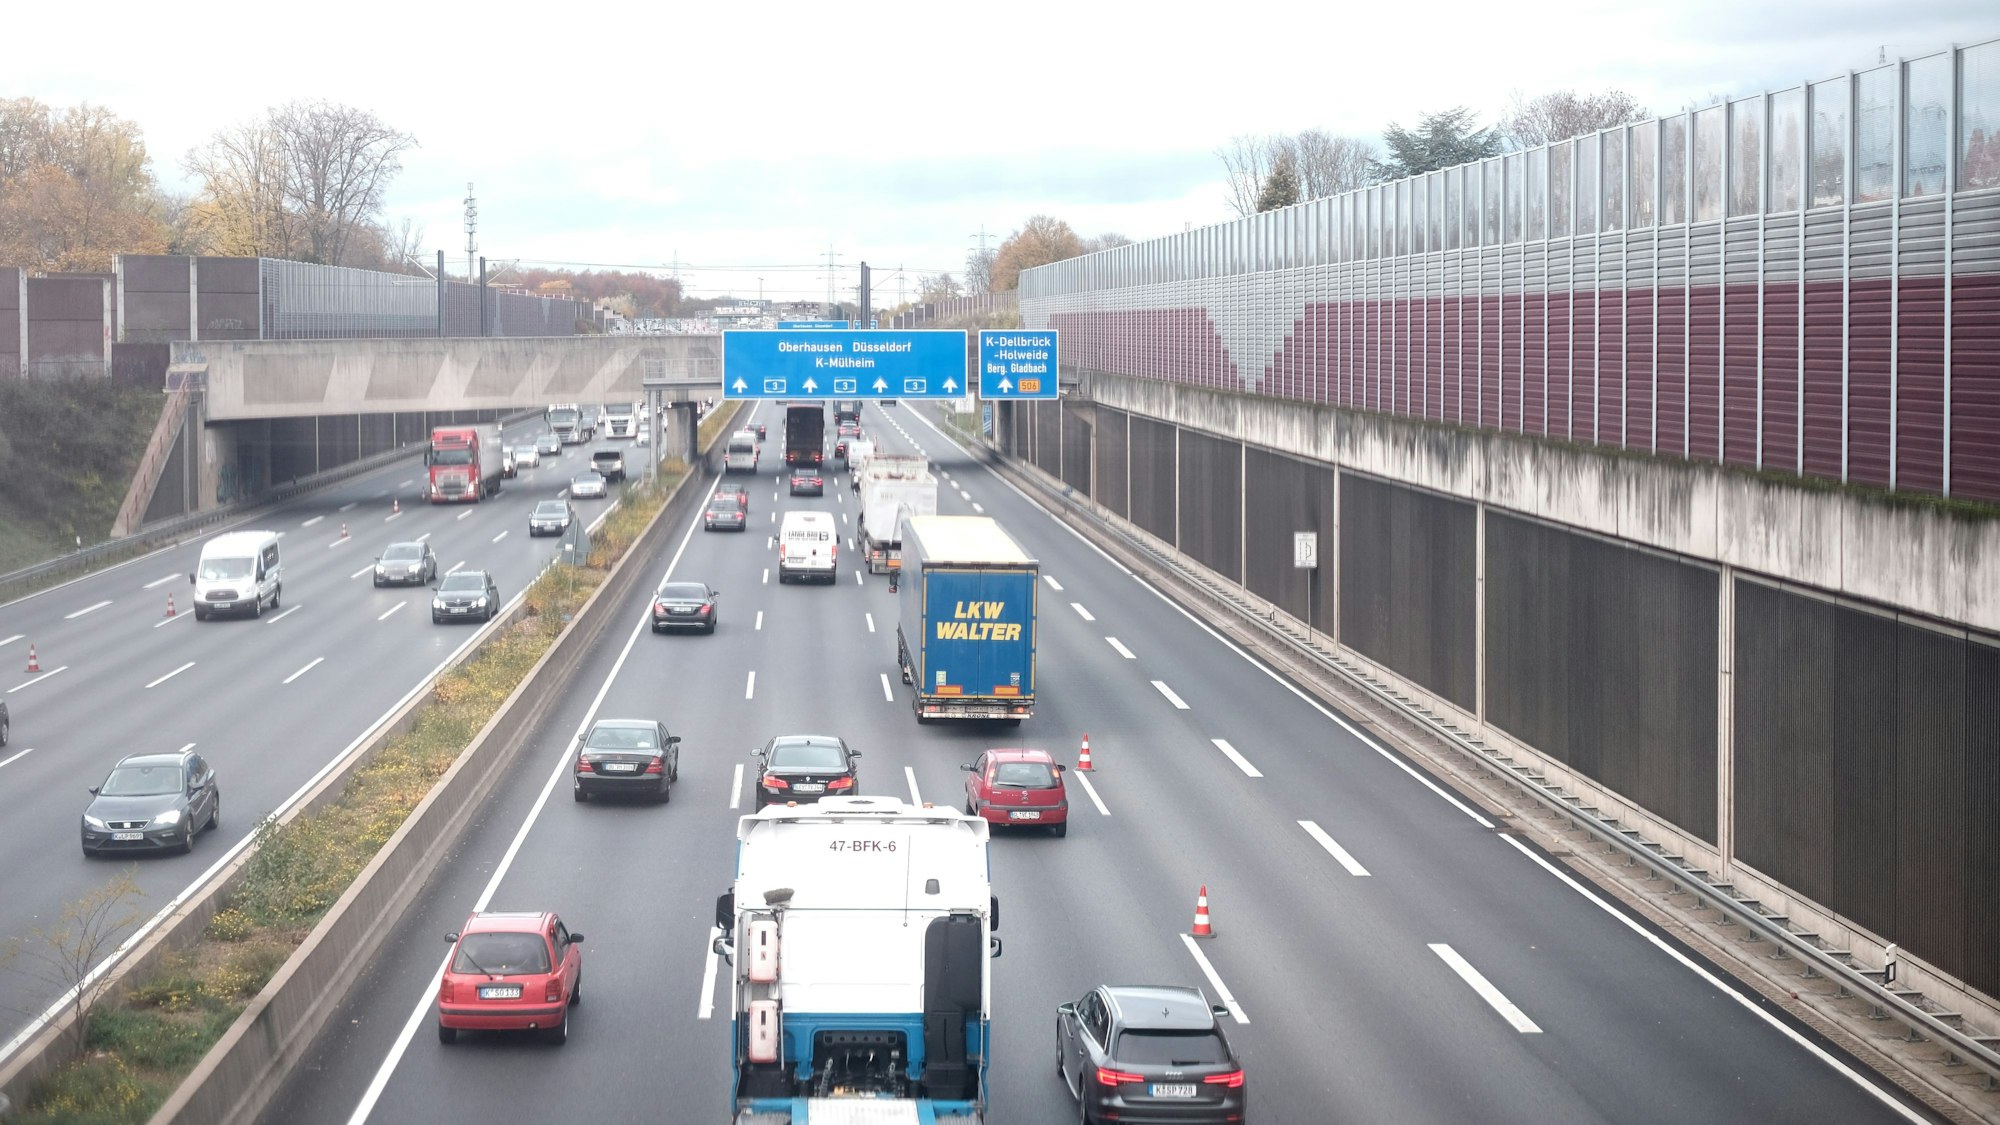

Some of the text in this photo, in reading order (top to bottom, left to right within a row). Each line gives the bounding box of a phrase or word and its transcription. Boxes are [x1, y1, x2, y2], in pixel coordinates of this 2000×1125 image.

[778, 341, 912, 352] Oberhausen Düsseldorf
[986, 336, 1051, 347] K-Dellbrück
[993, 349, 1049, 360] -Holweide
[815, 357, 875, 368] K-Mülheim
[987, 362, 1047, 375] Berg. Gladbach
[772, 381, 918, 390] 3 3 3
[1021, 381, 1037, 390] 506
[954, 601, 1005, 619] LKW
[937, 622, 1021, 641] WALTER
[829, 840, 897, 852] 47-BFK-6
